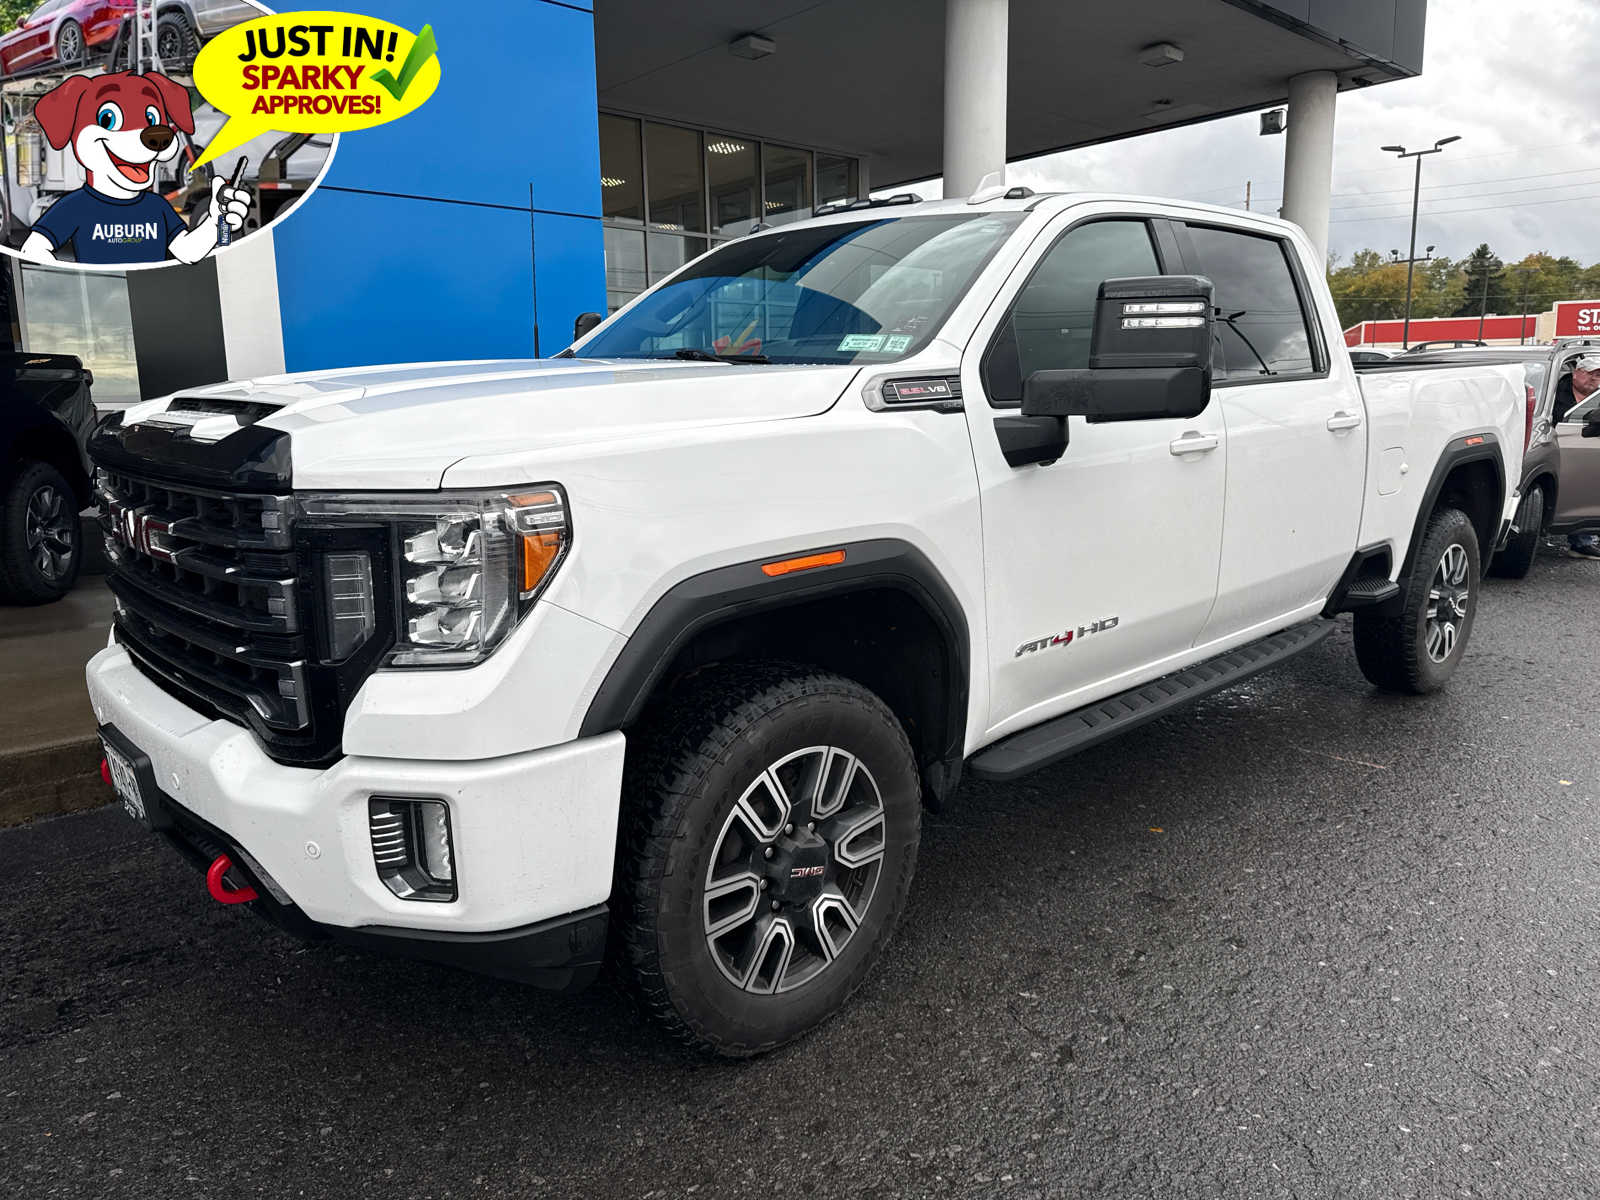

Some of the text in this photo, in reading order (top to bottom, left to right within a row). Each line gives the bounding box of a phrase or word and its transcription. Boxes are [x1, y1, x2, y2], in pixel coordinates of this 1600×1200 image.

[1015, 616, 1119, 658] AT4 HD
[790, 865, 825, 878] GMC
